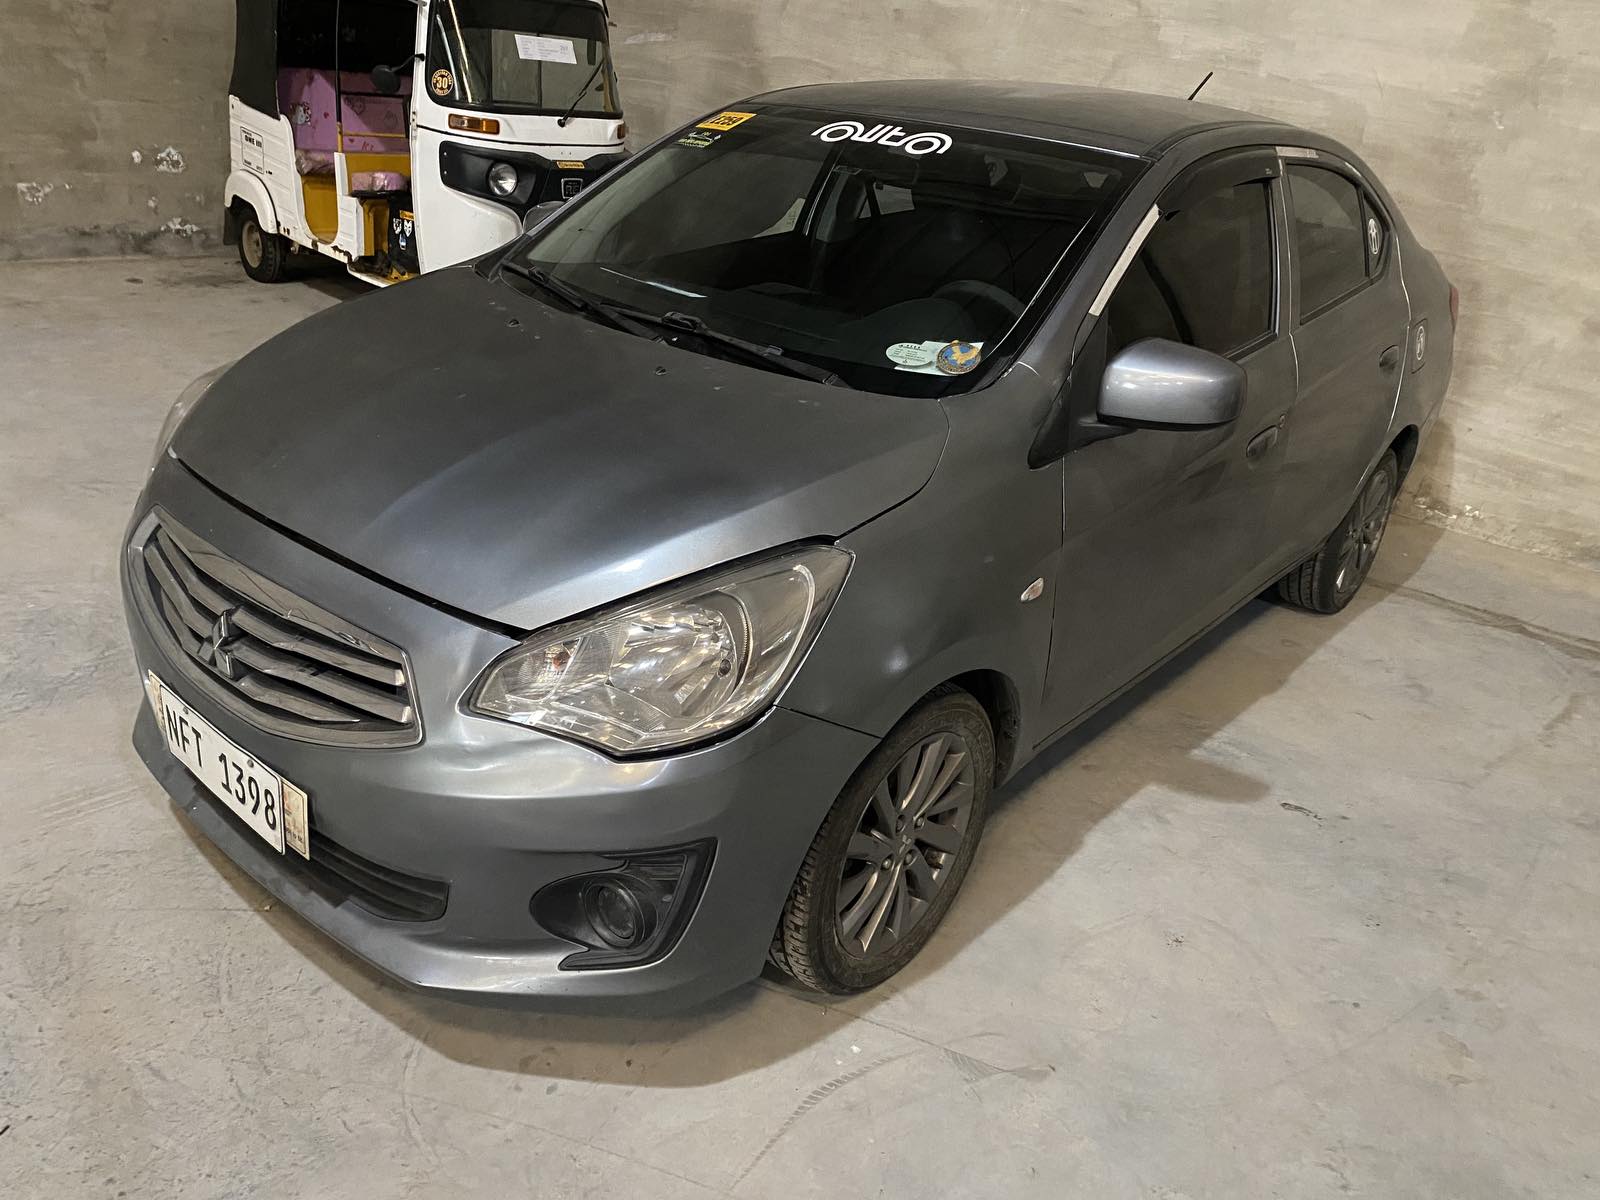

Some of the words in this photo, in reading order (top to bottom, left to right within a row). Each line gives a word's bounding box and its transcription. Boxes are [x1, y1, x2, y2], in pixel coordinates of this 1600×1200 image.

[436, 77, 448, 89] 30
[165, 704, 202, 769] NFT
[218, 752, 277, 831] 1398
